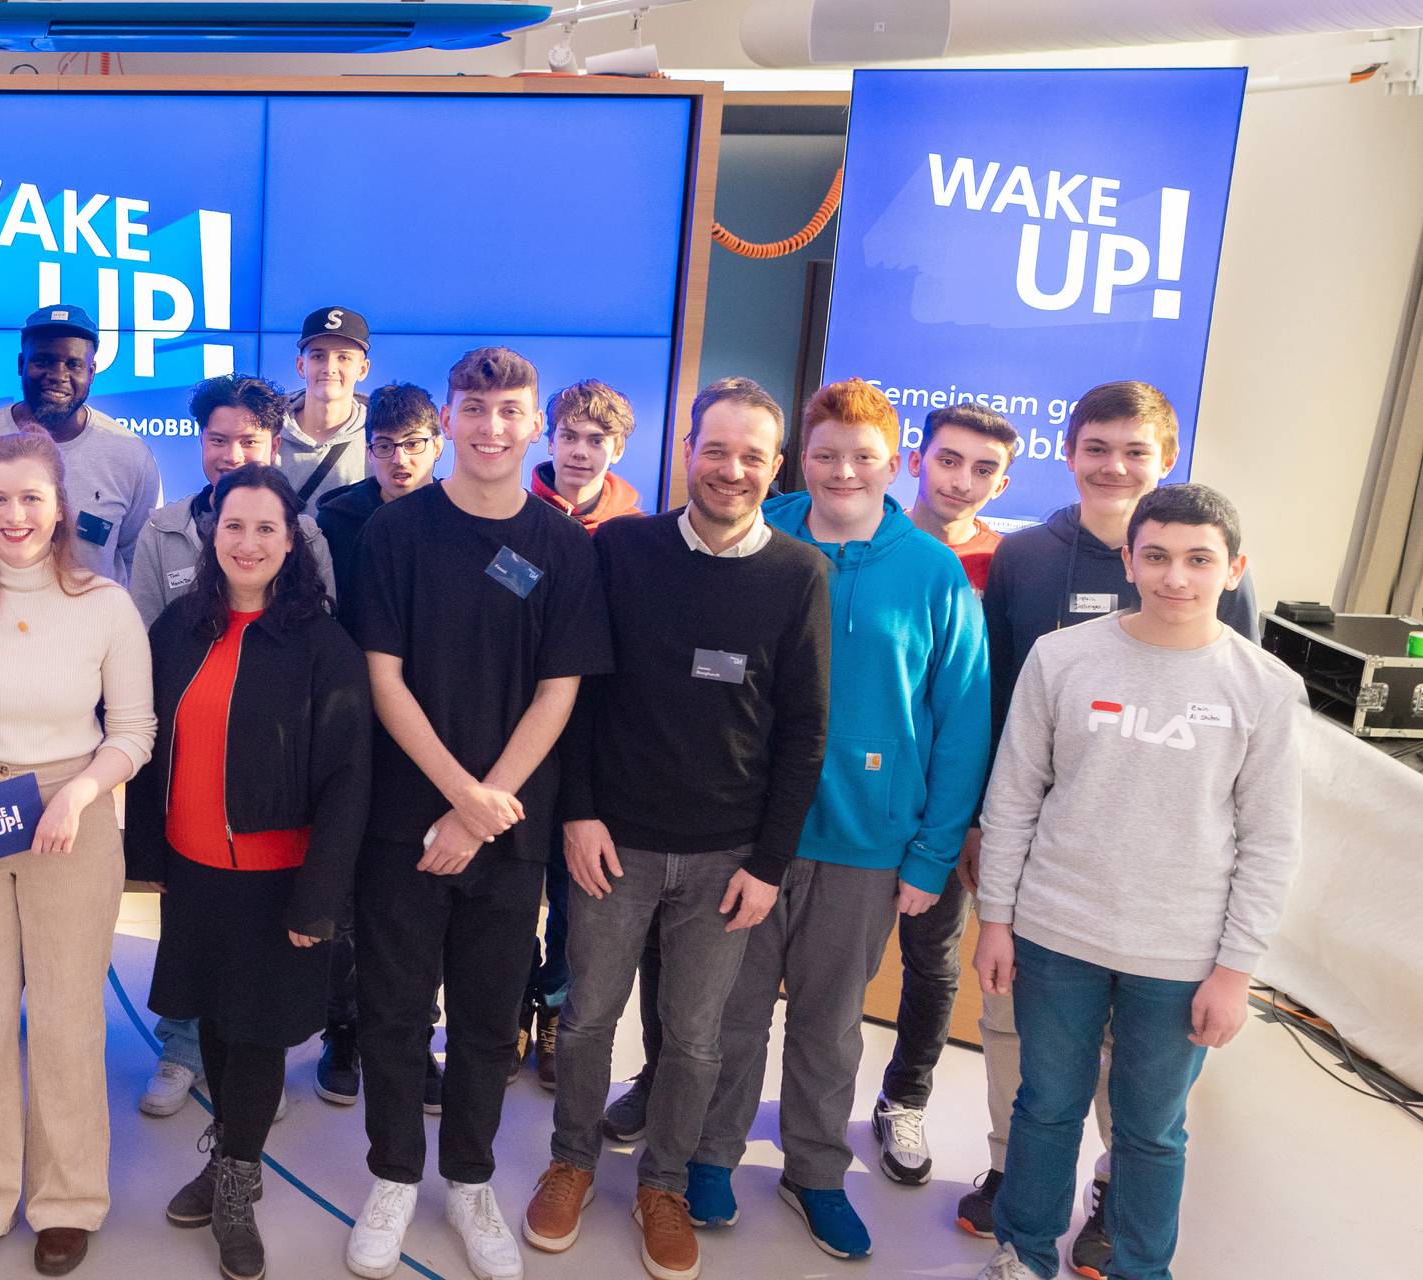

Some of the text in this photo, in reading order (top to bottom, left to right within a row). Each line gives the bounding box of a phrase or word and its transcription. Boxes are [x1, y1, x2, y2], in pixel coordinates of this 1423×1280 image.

[928, 153, 1120, 227] WAKE
[1016, 187, 1190, 320] UP!
[38, 208, 234, 379] UP!
[324, 310, 344, 330] S
[1088, 700, 1196, 750] FILA
